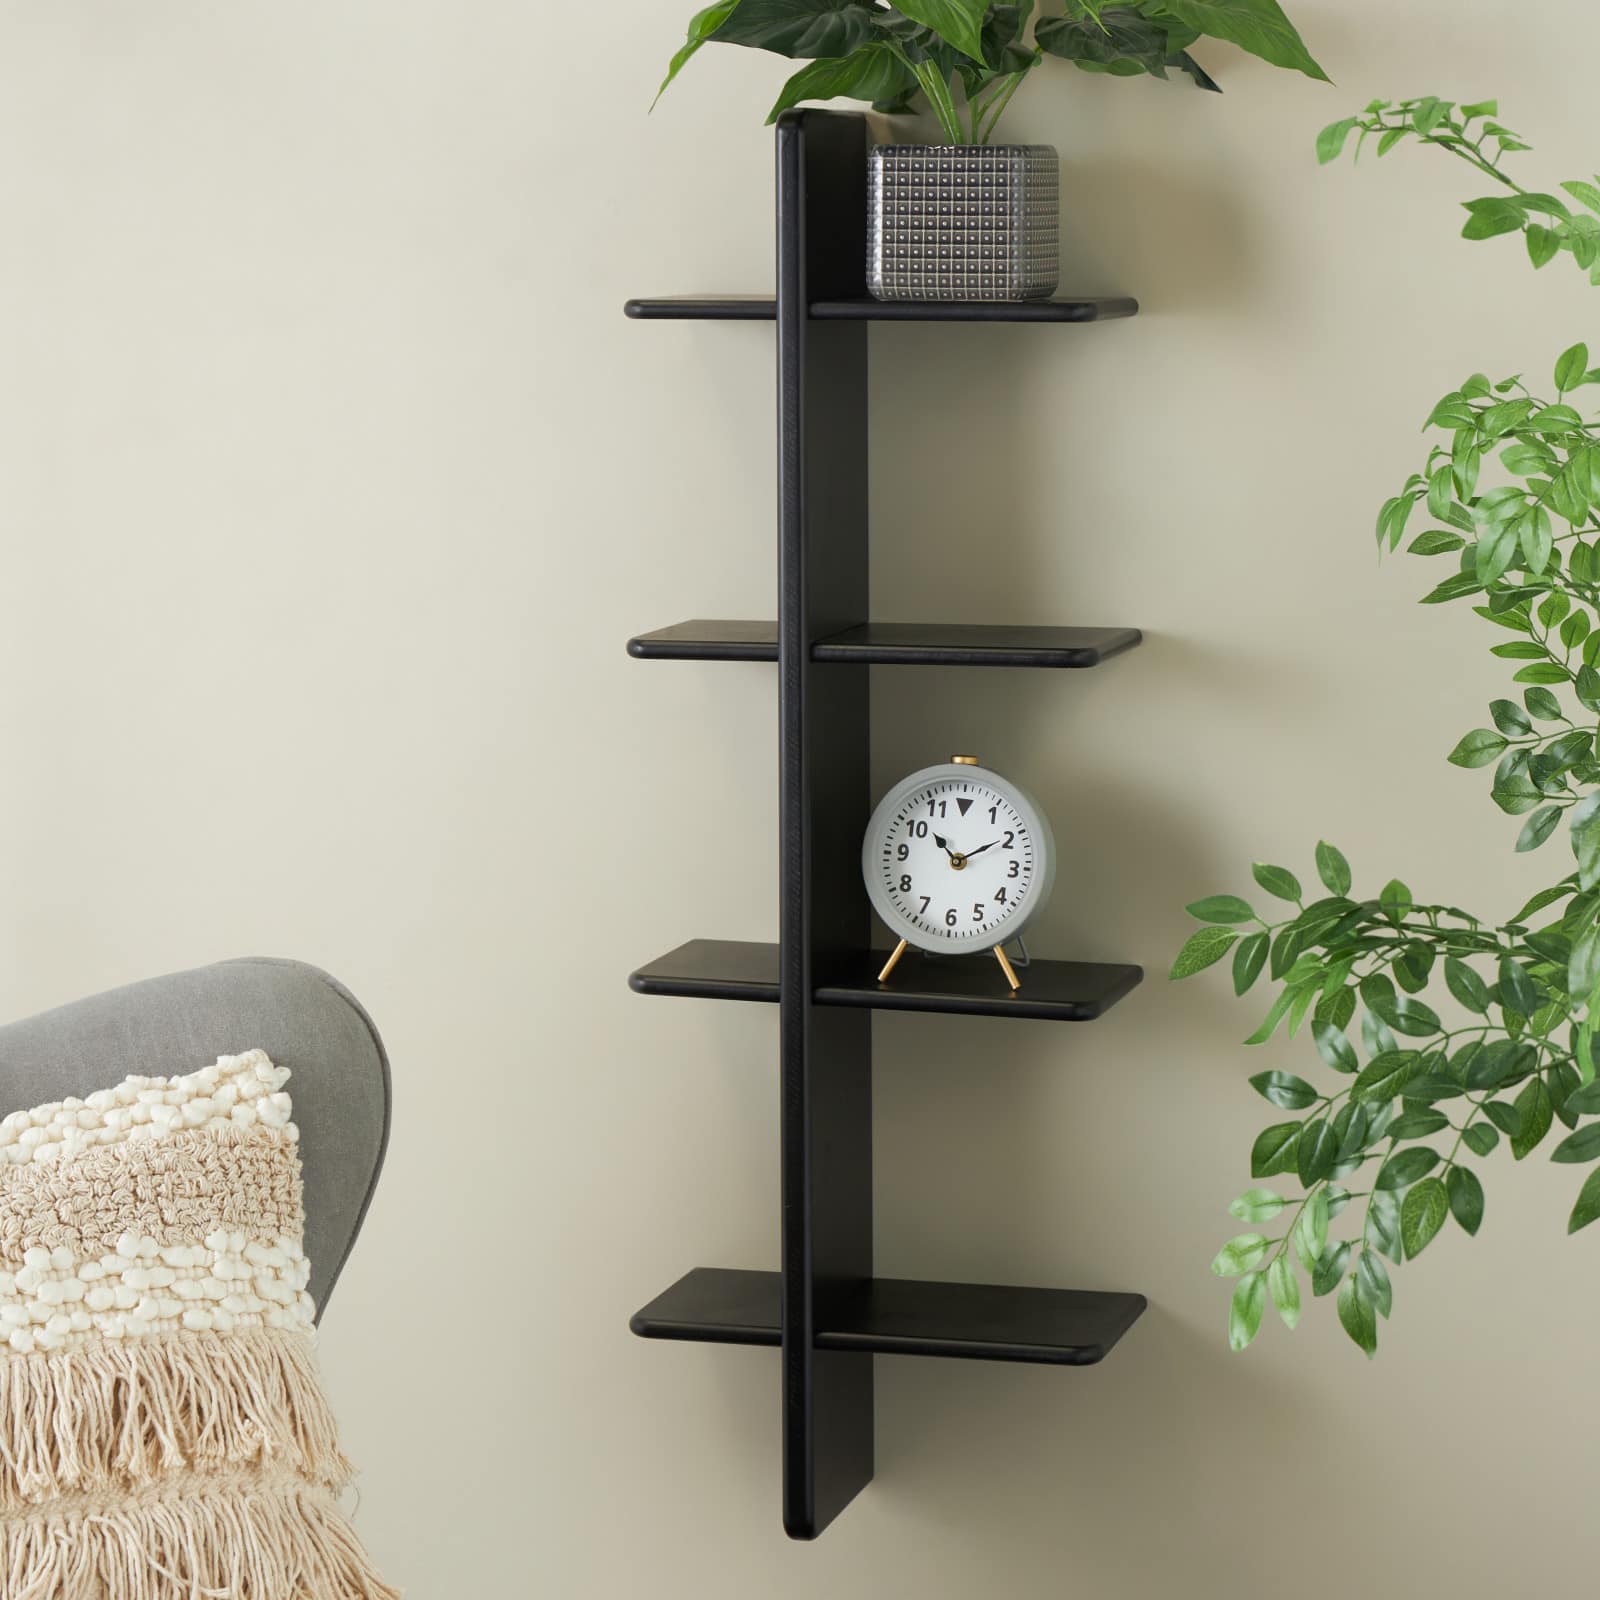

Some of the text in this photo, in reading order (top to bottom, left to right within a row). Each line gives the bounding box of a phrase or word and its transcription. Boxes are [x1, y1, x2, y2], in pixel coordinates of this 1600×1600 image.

[927, 799, 947, 818] 11
[988, 806, 997, 824] 1
[906, 819, 928, 838] 10
[1002, 831, 1014, 849] 2
[897, 844, 909, 861] 9
[1007, 860, 1019, 878] 3
[900, 874, 912, 892] 8
[919, 896, 931, 914] 7
[994, 887, 1007, 905] 4
[945, 908, 957, 926] 6
[972, 903, 985, 921] 5
